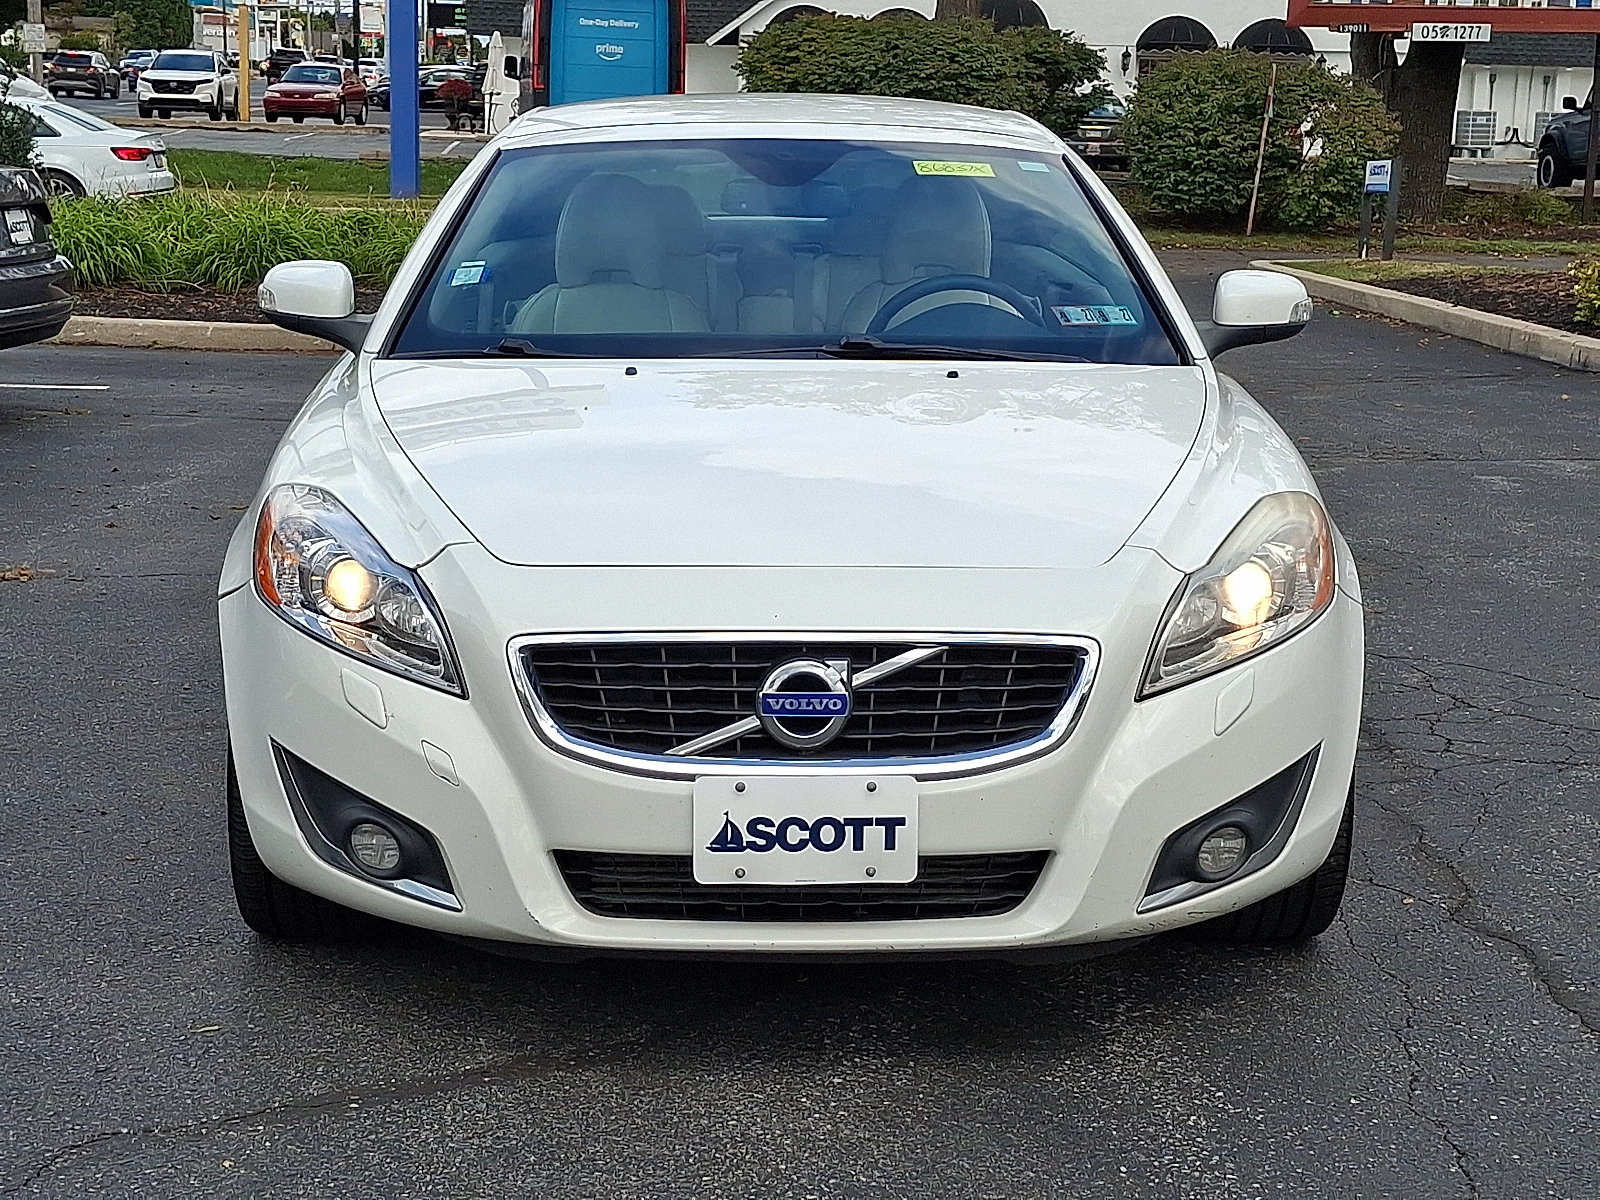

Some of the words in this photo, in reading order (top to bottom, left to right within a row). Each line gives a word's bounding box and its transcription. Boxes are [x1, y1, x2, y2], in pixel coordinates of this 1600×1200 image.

[609, 19, 639, 29] Delivery
[203, 28, 236, 37] verizn
[1453, 25, 1482, 40] 1277
[595, 43, 624, 54] prime
[766, 698, 842, 710] VOLVO
[746, 816, 907, 853] SCOTT
